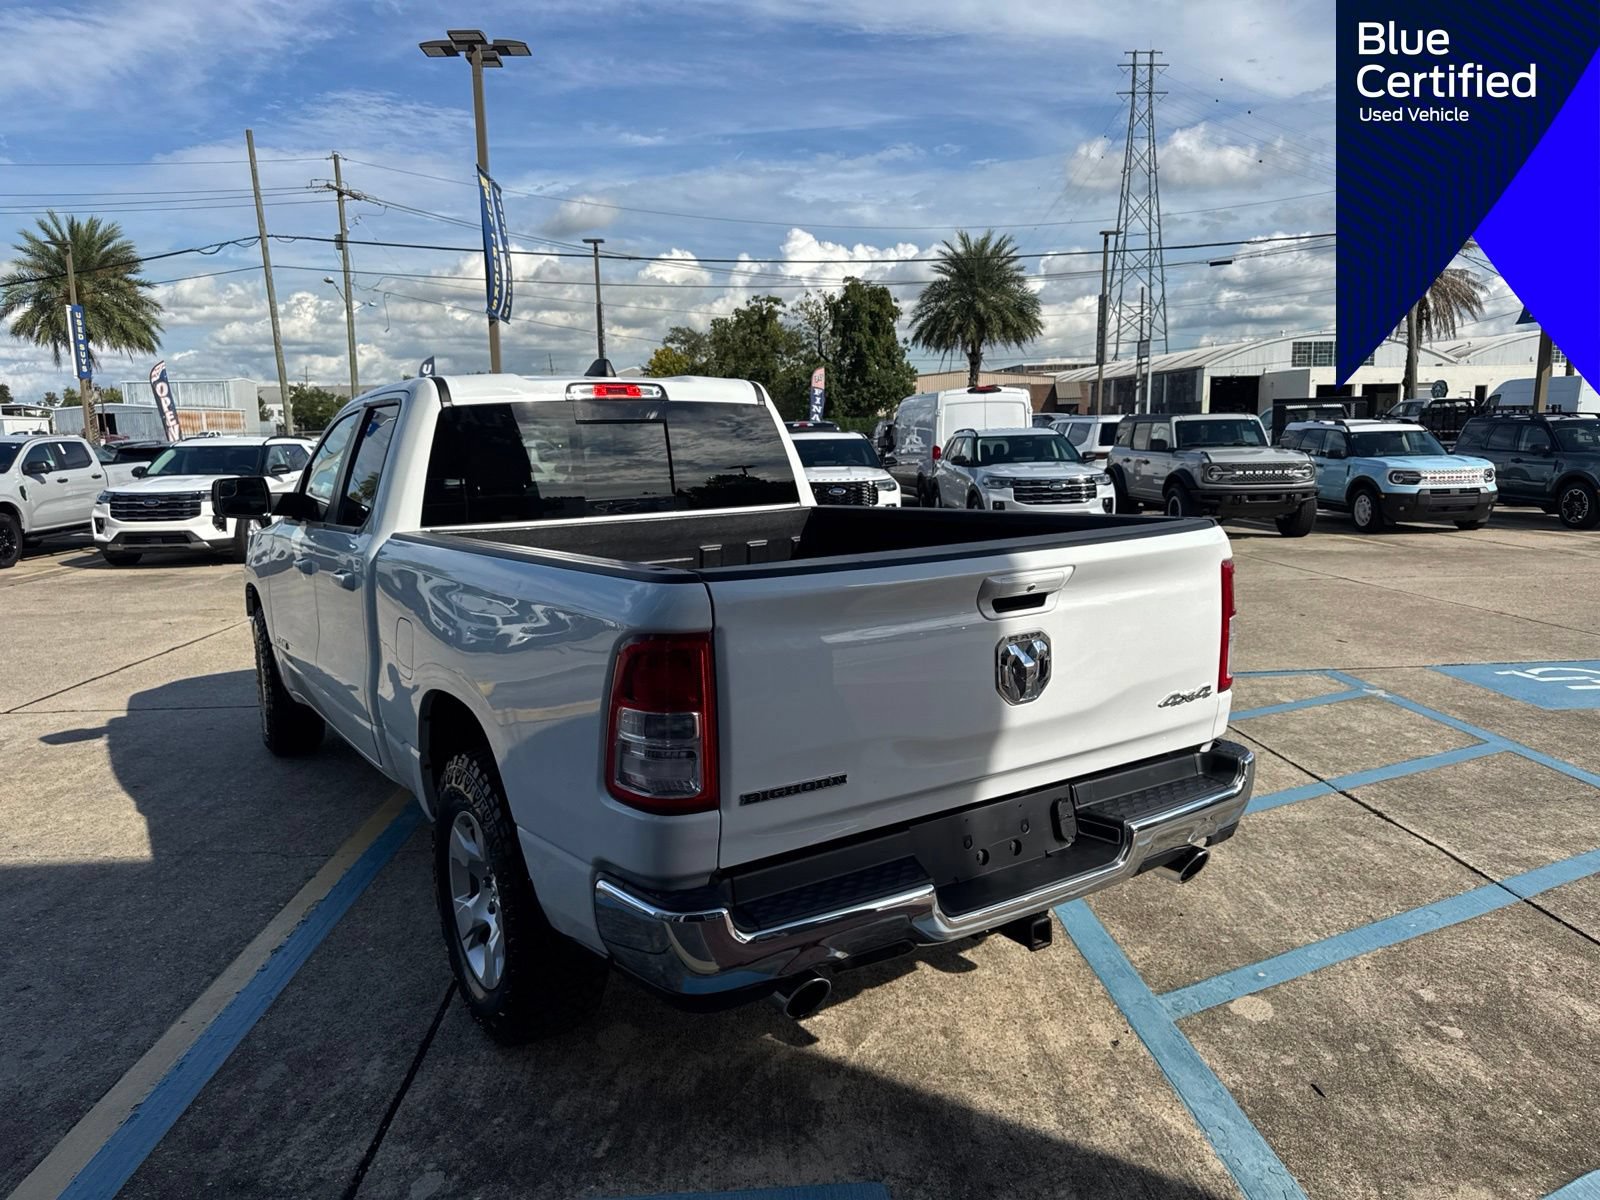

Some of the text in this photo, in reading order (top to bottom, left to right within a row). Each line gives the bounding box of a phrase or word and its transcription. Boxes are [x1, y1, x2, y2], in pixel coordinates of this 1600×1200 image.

[491, 232, 500, 310] TRUCKS
[75, 311, 88, 372] USED SUVS
[155, 381, 180, 441] OPEN
[1008, 631, 1042, 643] RAM
[1158, 685, 1212, 708] 4x4
